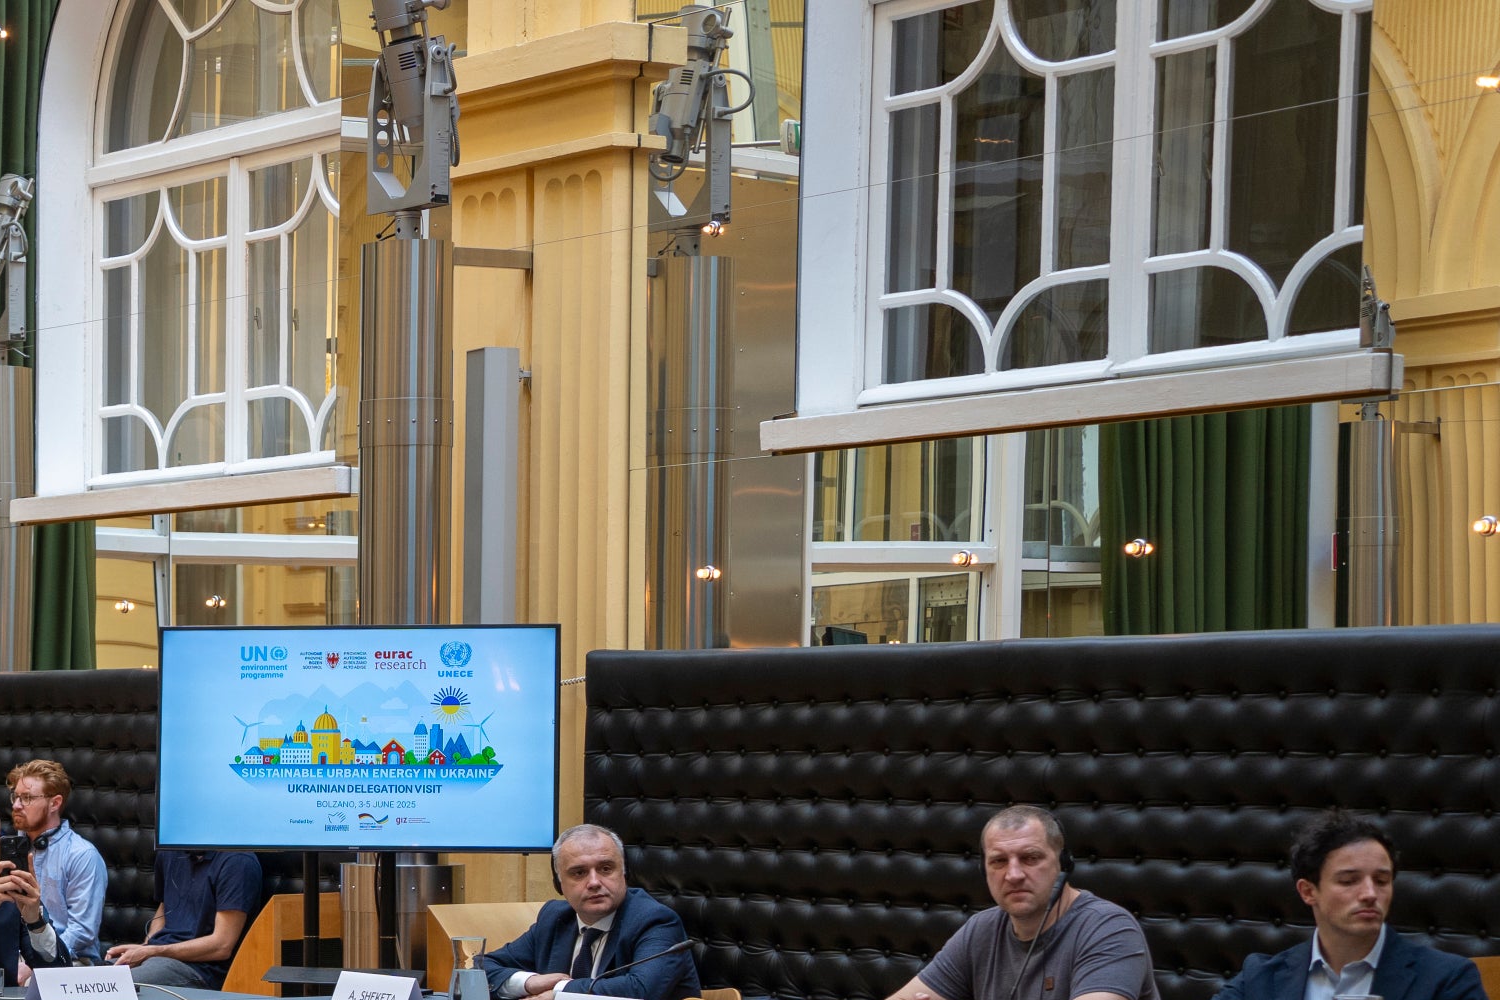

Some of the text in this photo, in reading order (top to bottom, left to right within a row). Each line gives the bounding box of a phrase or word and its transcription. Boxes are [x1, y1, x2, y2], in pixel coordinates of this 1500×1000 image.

[240, 645, 268, 662] UN
[374, 650, 413, 660] eurac
[240, 663, 288, 671] environment
[375, 659, 427, 670] research
[240, 671, 284, 680] programme
[438, 670, 473, 678] UNECE
[241, 768, 495, 779] SUSTAINABLE URBAN ENERGY IN UKRAINE
[287, 783, 443, 794] UKRAINIAN DELEGATION VISIT
[316, 800, 416, 809] BOLZANO, 3-5 JUNE 2025
[59, 982, 119, 995] T. HAYDUK
[348, 989, 357, 1000] A.
